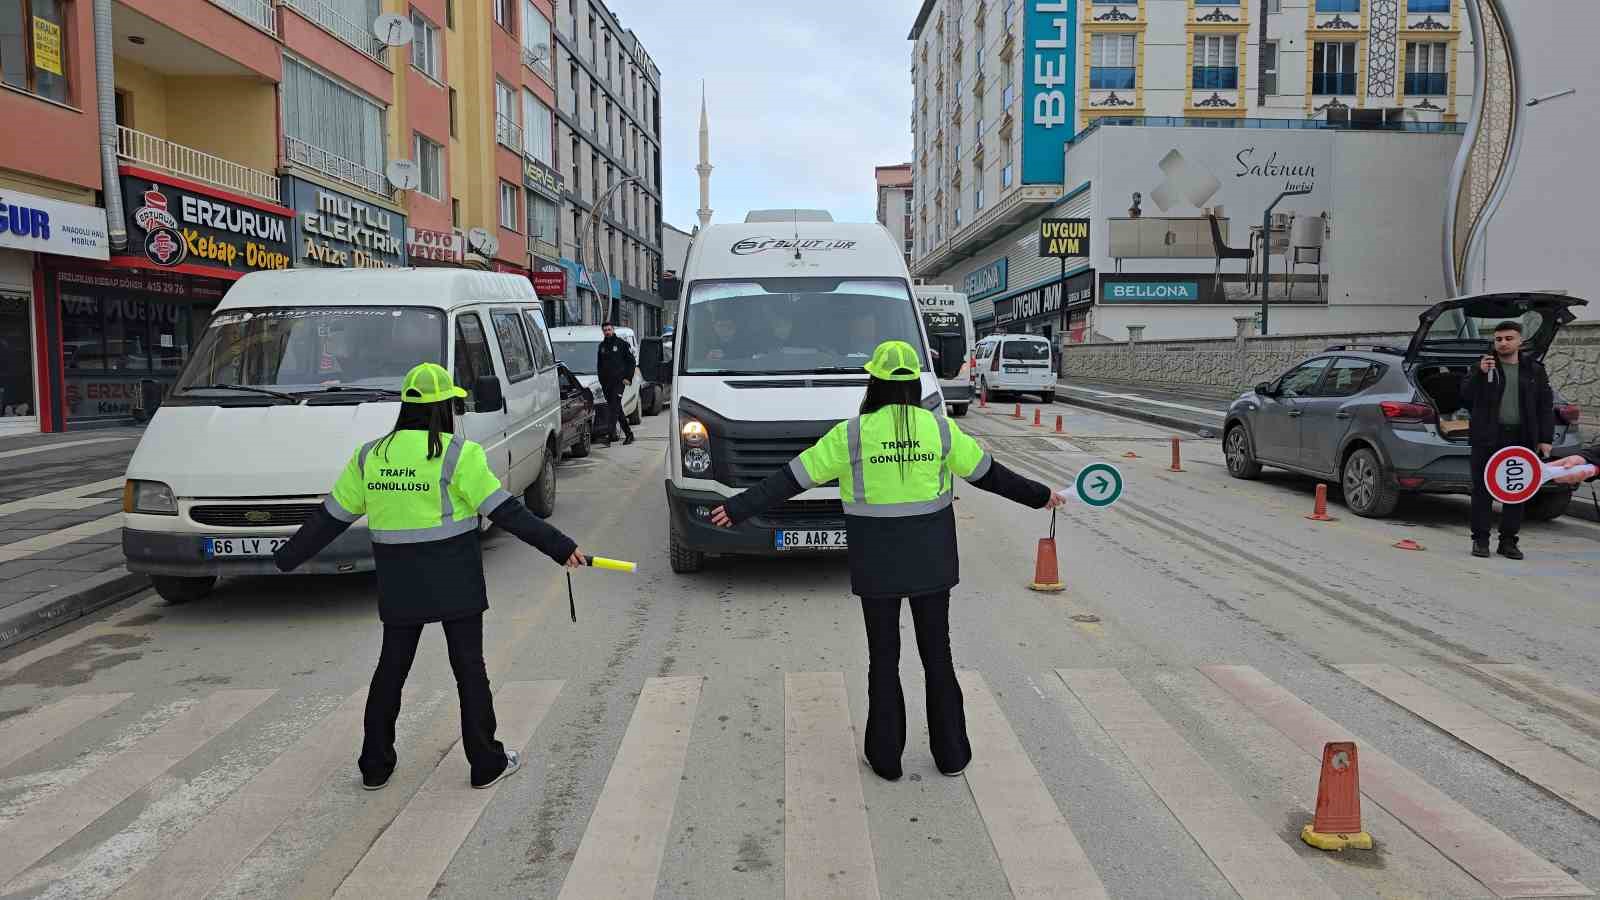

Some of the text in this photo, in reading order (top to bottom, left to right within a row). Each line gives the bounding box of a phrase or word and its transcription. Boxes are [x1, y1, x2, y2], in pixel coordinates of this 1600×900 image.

[1236, 147, 1314, 177] Salonun
[182, 195, 286, 243] ERZURUM
[319, 191, 390, 231] MUTLU
[304, 212, 401, 255] ELEKTRİK
[415, 230, 453, 247] FOTO
[1042, 222, 1087, 238] UYGUN
[183, 228, 236, 266] Kebap
[246, 242, 289, 269] Döner
[306, 238, 347, 266] Avize
[405, 243, 456, 264] VEYSEL
[1048, 238, 1079, 254] AVM
[1113, 285, 1188, 297] BELLONA
[1012, 290, 1041, 320] UYGUN
[380, 467, 416, 477] TRAFİK
[1506, 459, 1524, 491] STOP
[367, 481, 430, 491] GÖNÜLLÜSÜ
[214, 540, 233, 553] 66
[241, 540, 260, 553] LY
[784, 532, 799, 545] 66
[806, 532, 828, 545] AAR
